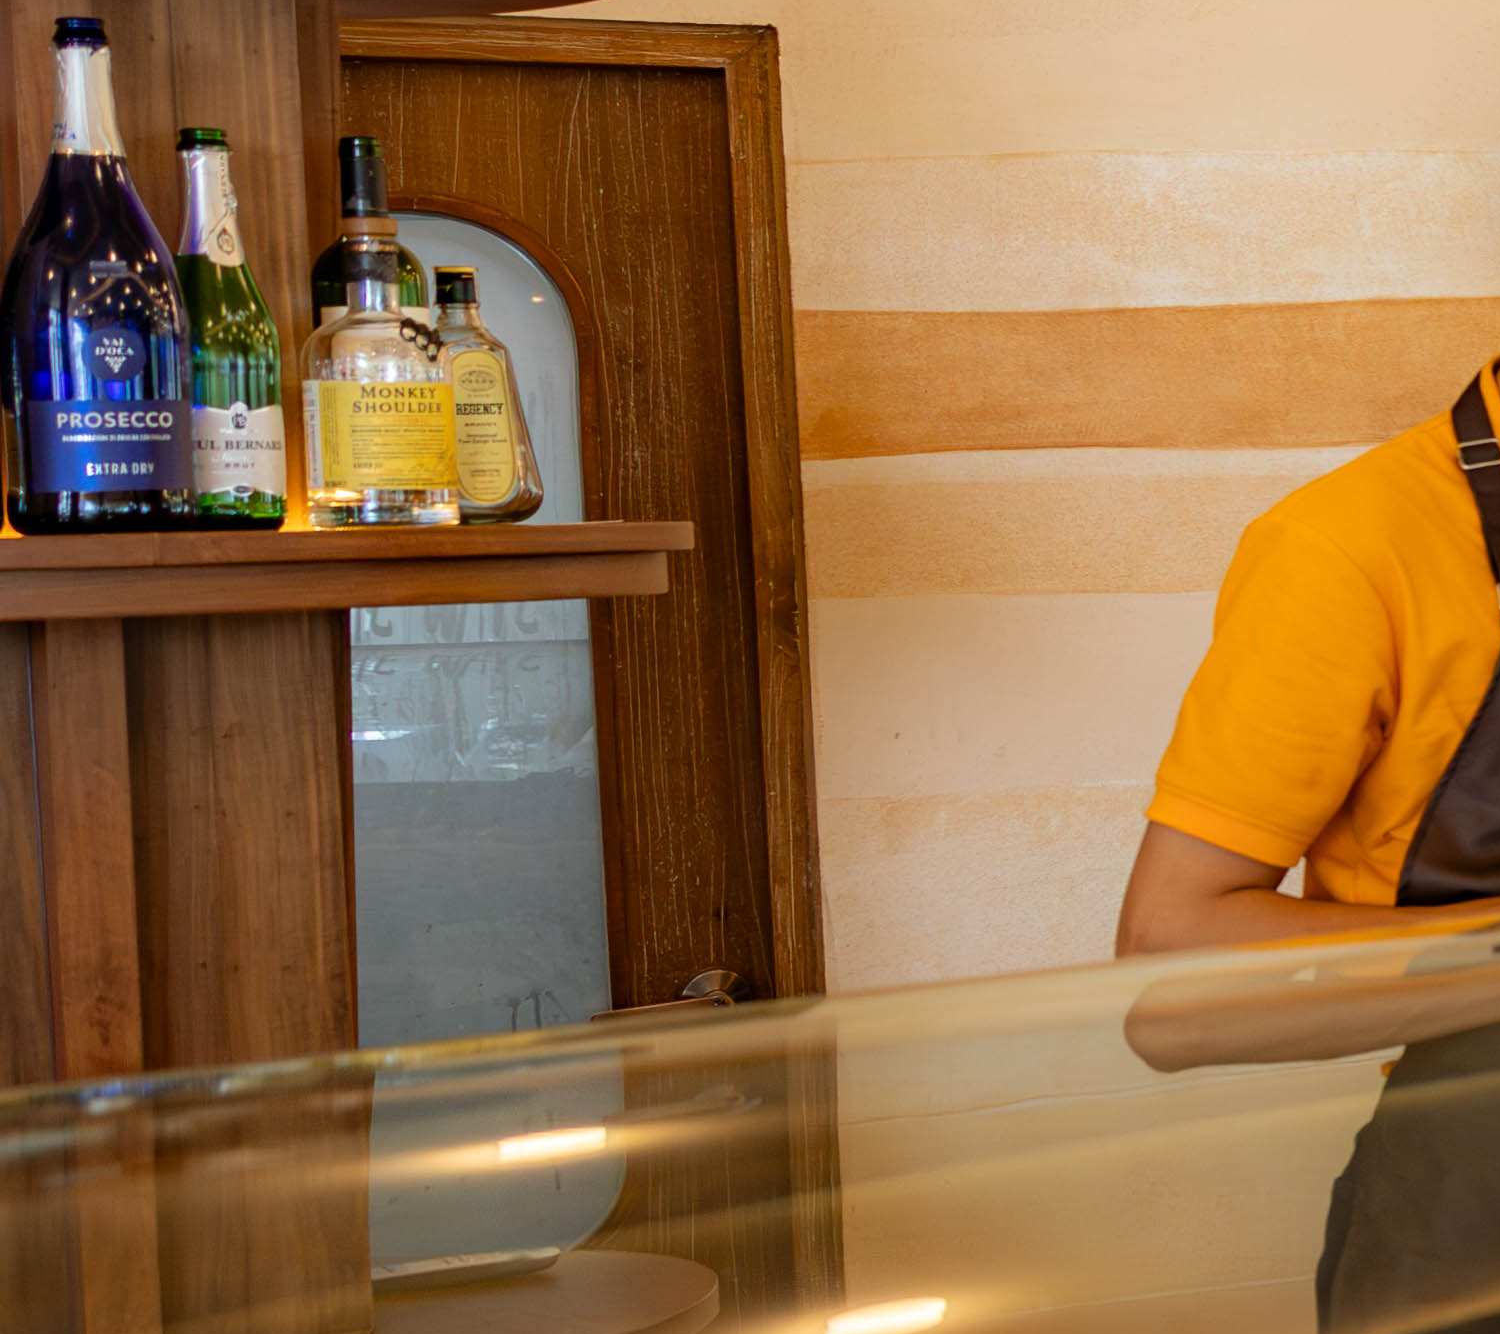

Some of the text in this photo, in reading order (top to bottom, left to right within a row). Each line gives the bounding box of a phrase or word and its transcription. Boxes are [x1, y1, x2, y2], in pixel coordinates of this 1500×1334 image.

[360, 386, 437, 399] MONKEY
[352, 401, 442, 414] SHOULDER
[456, 403, 504, 416] REGENCY
[56, 411, 173, 429] PROSECCO
[86, 462, 155, 477] EXTRA DRY
